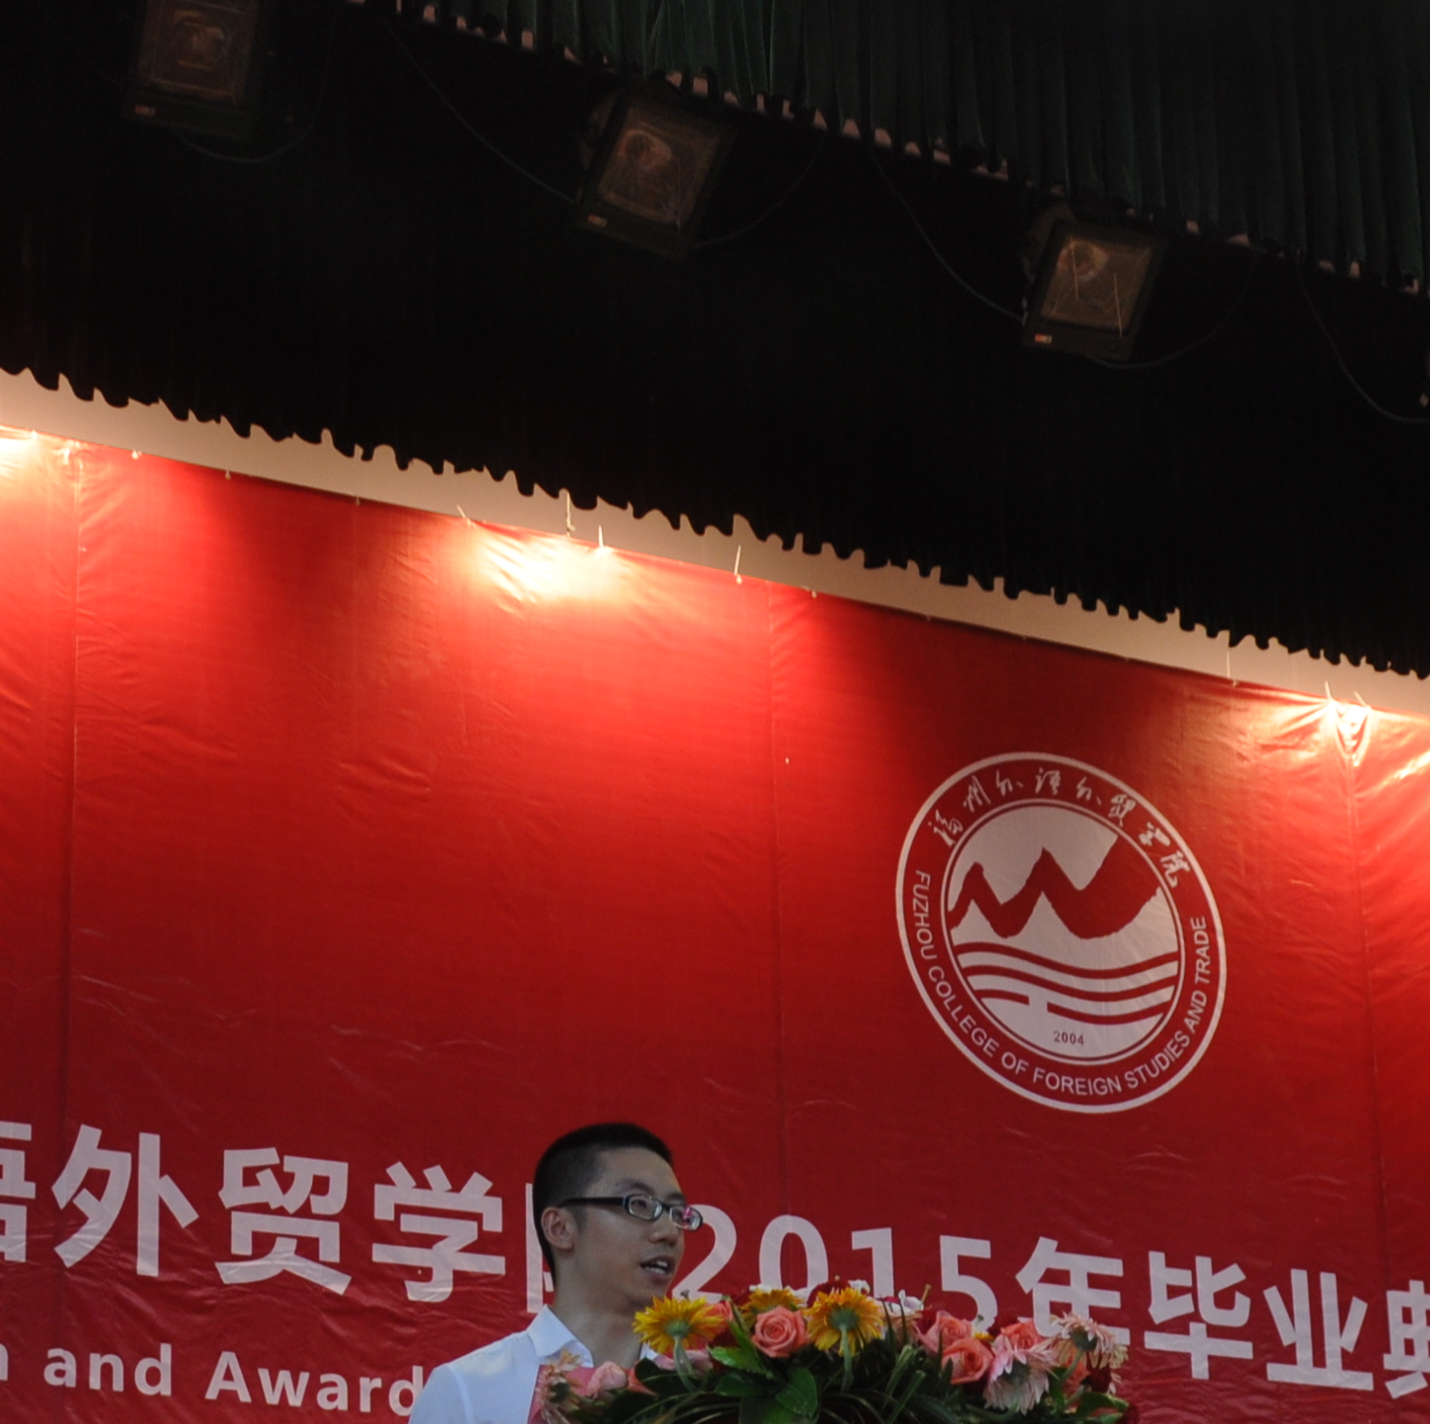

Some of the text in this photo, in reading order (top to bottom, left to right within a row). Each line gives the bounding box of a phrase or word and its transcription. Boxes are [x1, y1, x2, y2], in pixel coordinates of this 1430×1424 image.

[913, 870, 1211, 1096] FUZHOU COLLEGE OF FOREIGN STUDIES AND TRADE
[43, 1342, 172, 1397] and
